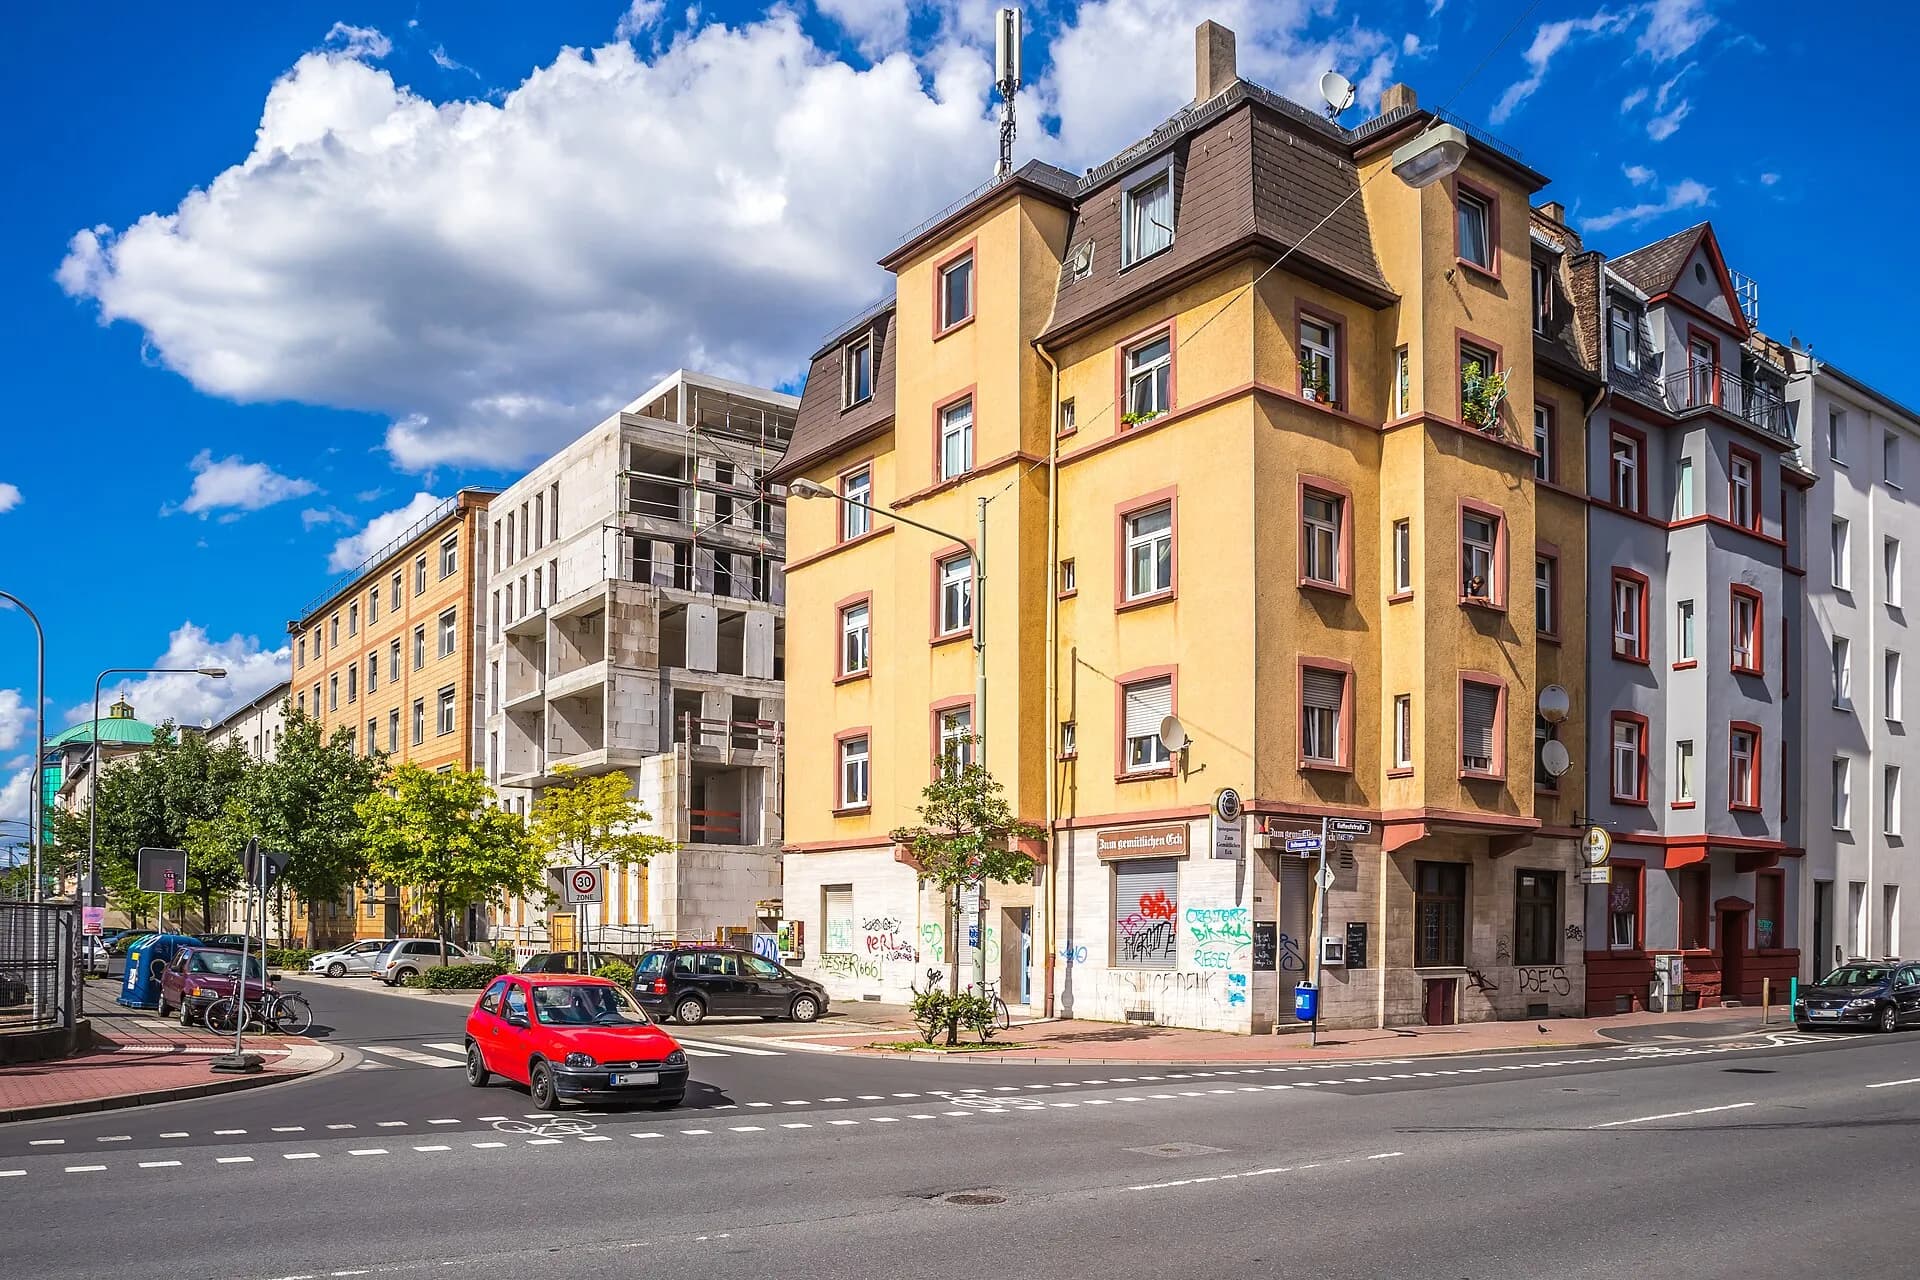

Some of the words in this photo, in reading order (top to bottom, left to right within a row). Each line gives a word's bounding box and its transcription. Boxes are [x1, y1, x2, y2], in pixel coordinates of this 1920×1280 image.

[1099, 838, 1116, 850] Zum
[1118, 834, 1165, 850] gemütlichen
[1166, 833, 1182, 846] Eck
[577, 876, 591, 888] 30
